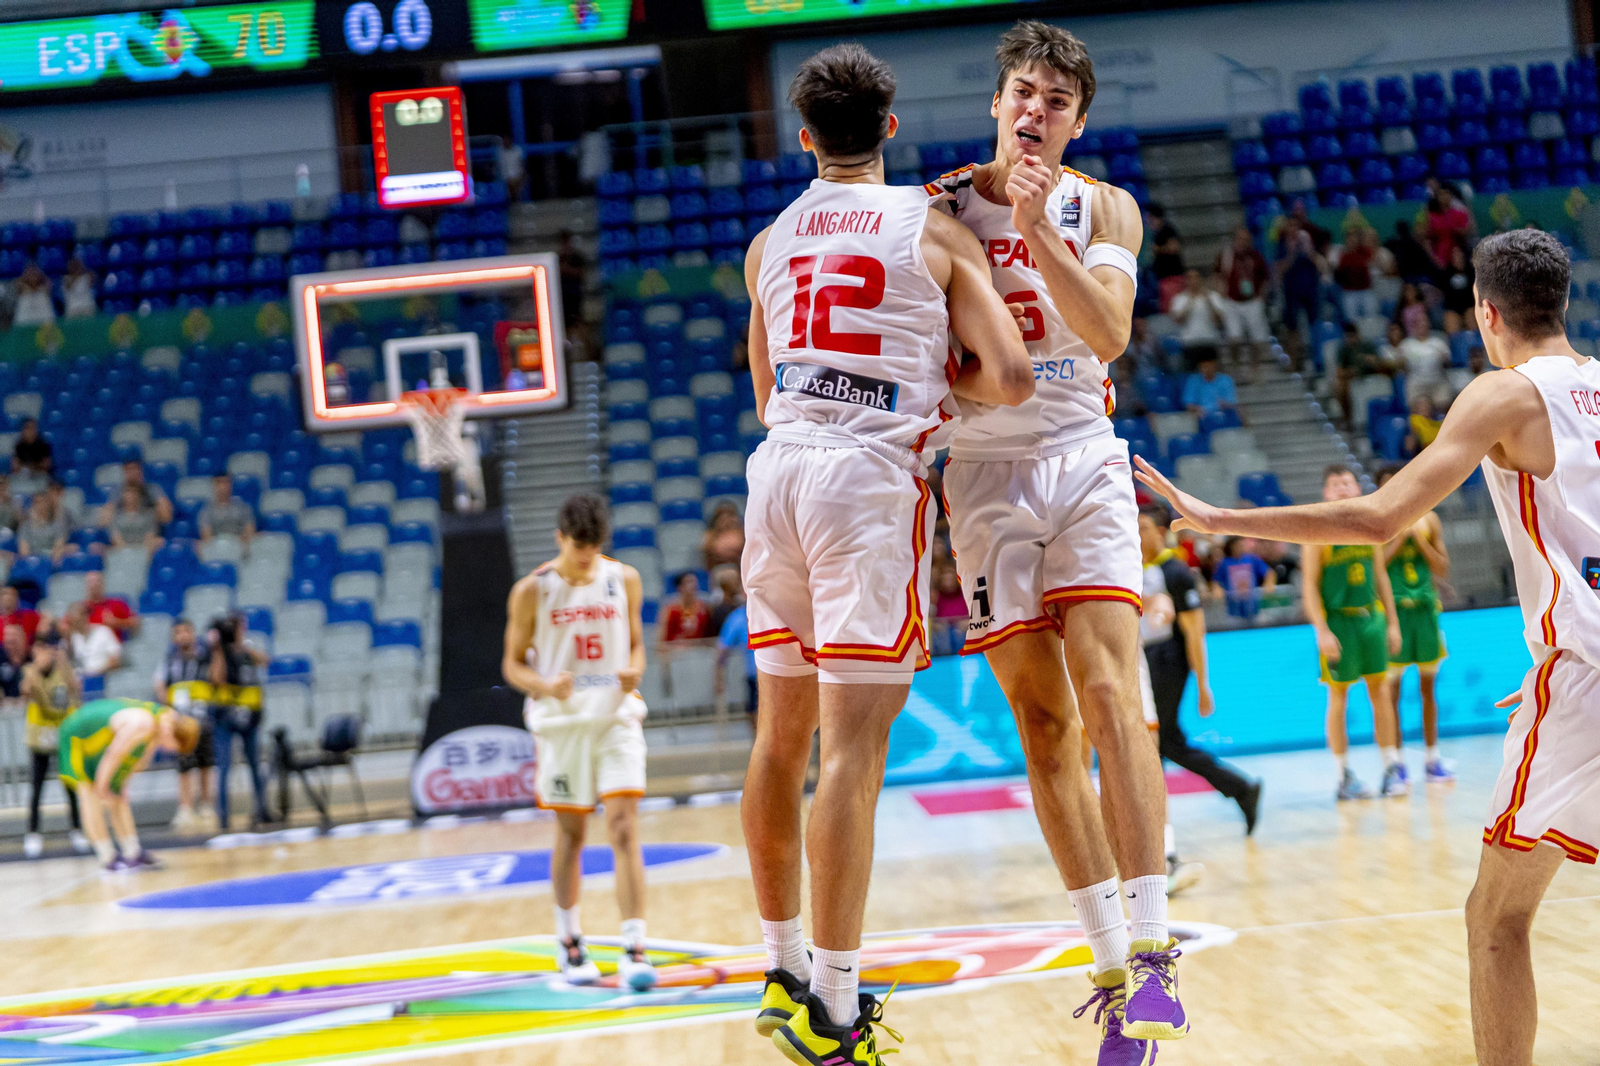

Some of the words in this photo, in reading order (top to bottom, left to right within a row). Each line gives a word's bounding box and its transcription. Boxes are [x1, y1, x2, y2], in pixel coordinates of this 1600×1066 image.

[227, 11, 285, 58] 70
[343, 0, 432, 55] 0.0
[38, 31, 120, 76] ESP
[795, 210, 883, 237] LANGARITA
[787, 254, 886, 356] 12
[781, 365, 889, 411] CaixaBank
[573, 633, 605, 661] 16
